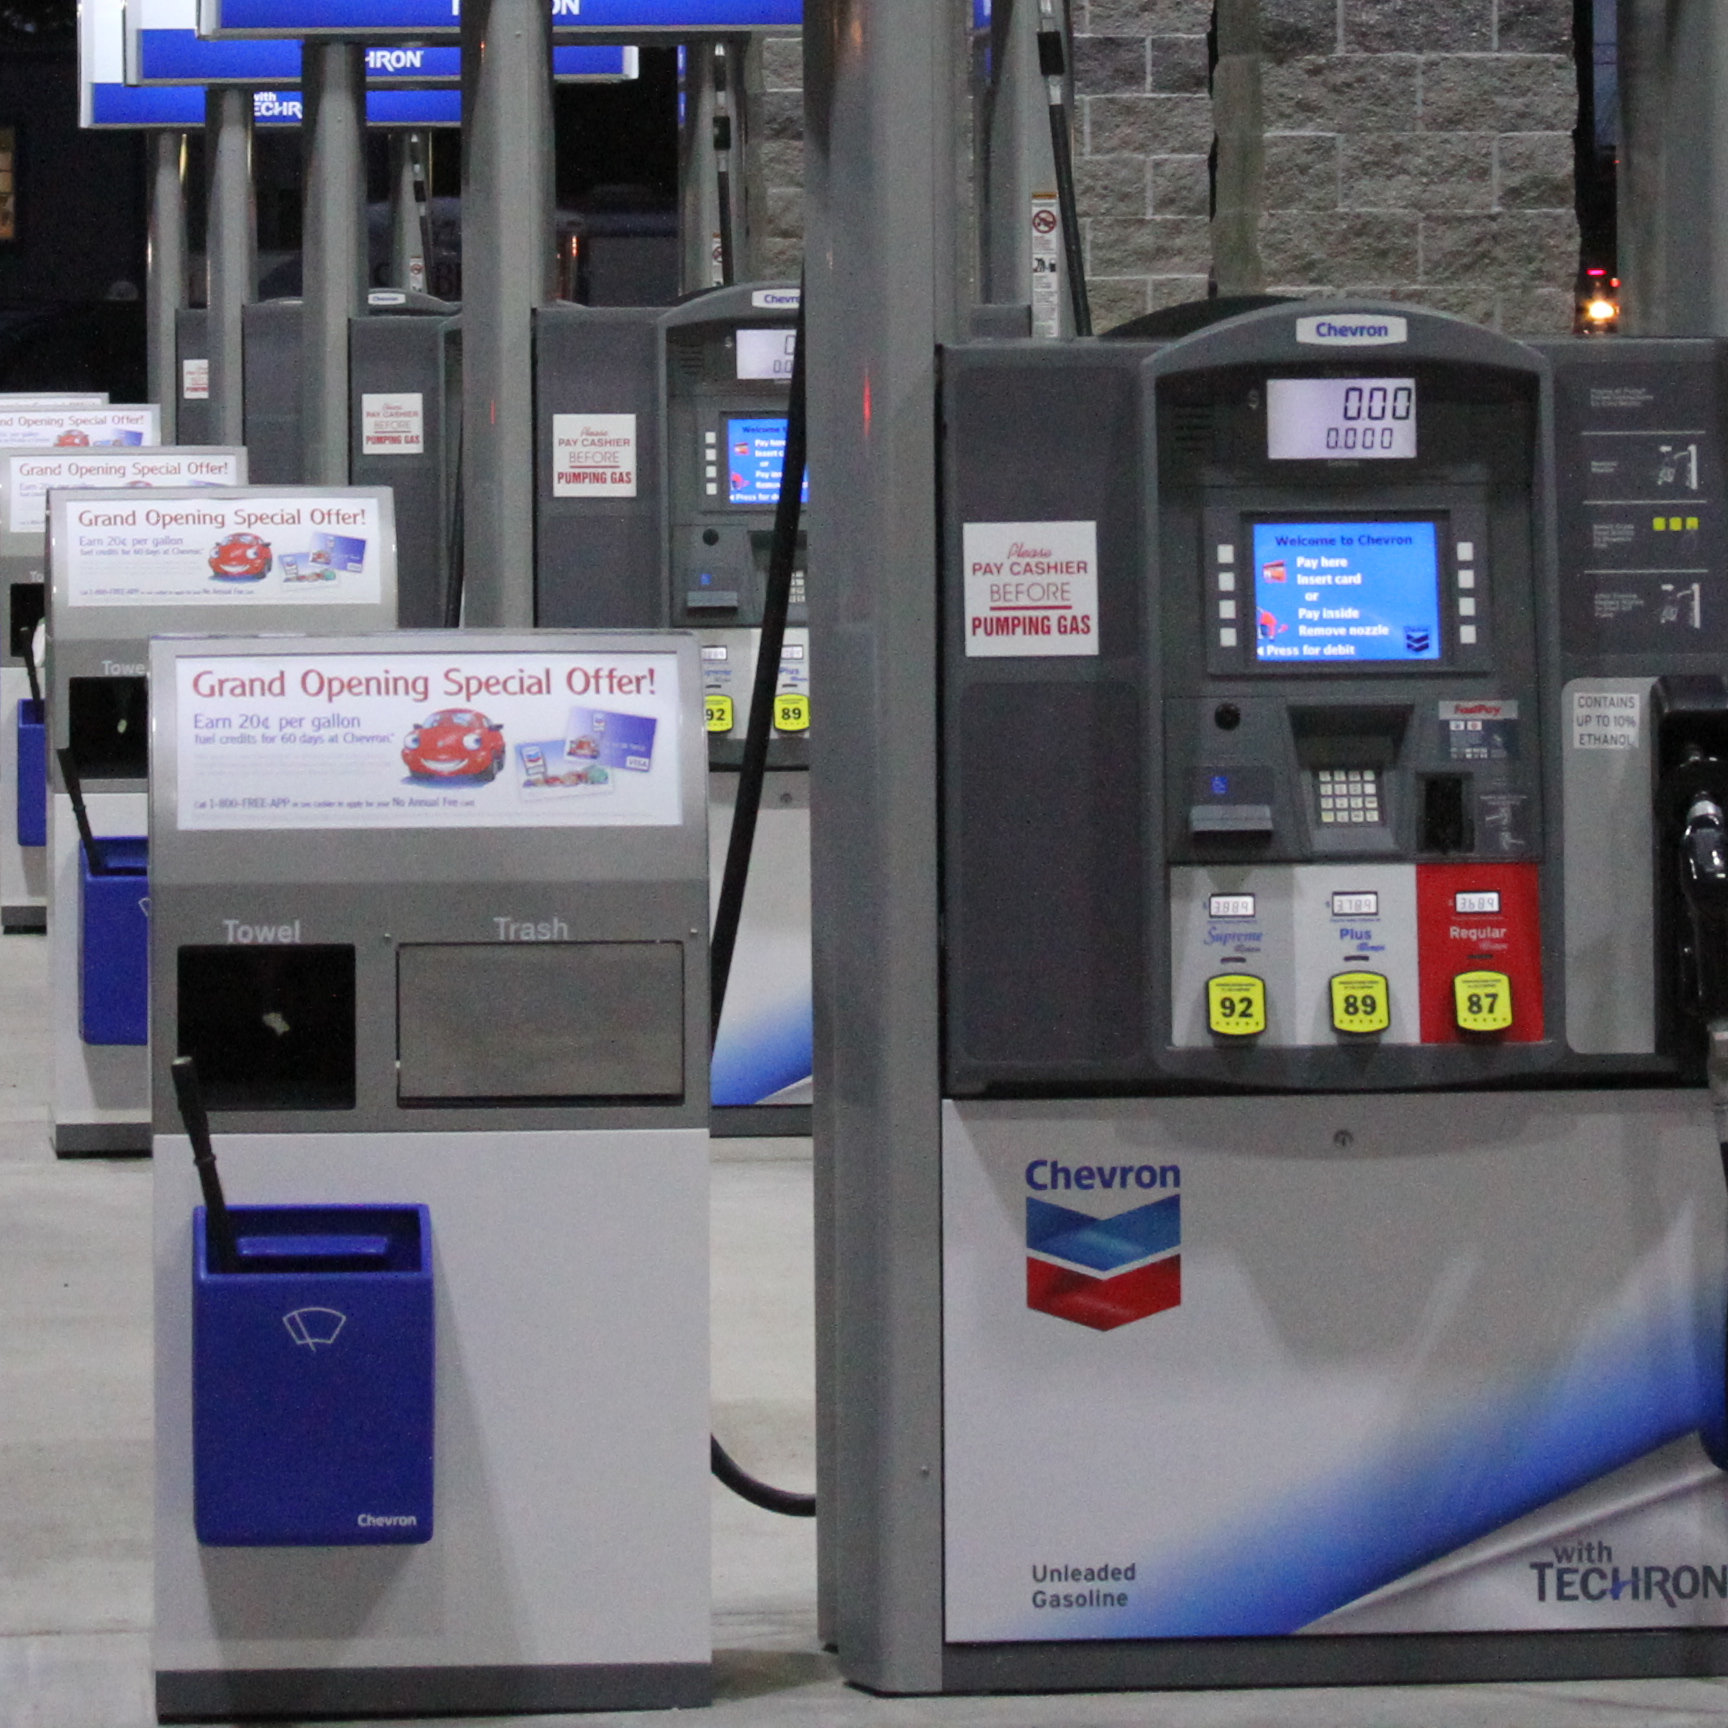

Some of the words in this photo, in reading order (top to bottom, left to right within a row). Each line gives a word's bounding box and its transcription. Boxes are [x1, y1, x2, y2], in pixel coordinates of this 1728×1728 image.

[764, 294, 800, 304] Chevr
[1316, 322, 1389, 337] Chevron
[558, 438, 578, 447] PAY
[582, 438, 630, 447] CASHIER
[569, 452, 619, 463] BEFORE
[20, 463, 61, 476] Grand
[68, 462, 126, 477] Opening
[132, 462, 180, 477] Special
[187, 462, 228, 475] Offer!
[557, 472, 607, 484] PUMPING
[611, 472, 631, 484] GAS
[78, 510, 137, 527] Grand
[145, 509, 225, 529] Opening
[233, 509, 301, 529] Special
[310, 508, 366, 526] Offer!
[79, 536, 103, 546] Earn
[152, 535, 183, 547] gallon
[1275, 536, 1336, 546] Welcome
[1341, 535, 1354, 545] to
[1358, 534, 1413, 545] Chevron
[1007, 542, 1052, 559] Please
[972, 562, 1004, 575] PAY
[1010, 561, 1088, 575] CASHIER
[1296, 556, 1318, 569] Pay
[1321, 556, 1348, 567] here
[1297, 574, 1333, 585] Insert
[1335, 573, 1362, 585] card
[990, 582, 1071, 602] BEFORE
[1305, 592, 1319, 601] or
[1298, 608, 1320, 621] Pay
[1323, 608, 1360, 619] inside
[972, 615, 1051, 636] PUMPING
[1057, 614, 1091, 635] GAS
[1299, 625, 1347, 636] Remove
[1349, 625, 1389, 636] nozzle
[1267, 645, 1299, 655] Press
[1303, 645, 1320, 655] for
[1323, 644, 1355, 655] debit
[102, 661, 146, 676] Towe
[192, 669, 285, 699] Grand
[301, 668, 430, 703] Opening
[443, 667, 551, 703] Special
[566, 667, 655, 696] Offer!
[1578, 696, 1635, 709] CONTAINS
[706, 708, 725, 721] 92
[781, 707, 802, 720] 89
[193, 713, 232, 729] Earn
[239, 713, 270, 729] 20¢
[279, 716, 305, 731] per
[311, 713, 361, 732] gallon
[1576, 715, 1592, 727] UP
[1595, 715, 1610, 727] TO
[1613, 715, 1637, 728] 10%
[195, 733, 215, 745] fuel
[219, 733, 257, 745] credits
[261, 733, 276, 745] for
[280, 734, 297, 745] 60
[299, 733, 323, 746] days
[327, 733, 338, 744] at
[1579, 733, 1633, 746] ETHANOL
[223, 919, 301, 943] Towel
[493, 916, 569, 941] Trash
[1340, 928, 1371, 940] Plus
[1450, 926, 1507, 941] Regular
[1204, 927, 1263, 946] Supreme
[1220, 997, 1253, 1018] 92
[1344, 995, 1377, 1016] 89
[1467, 993, 1499, 1014] 87
[1026, 1159, 1181, 1191] Chevron
[357, 1514, 417, 1528] Chevron
[1555, 1539, 1612, 1565] with
[1032, 1563, 1136, 1584] Unleaded
[1529, 1562, 1728, 1607] TECHRON
[1032, 1588, 1128, 1609] Gasoline
